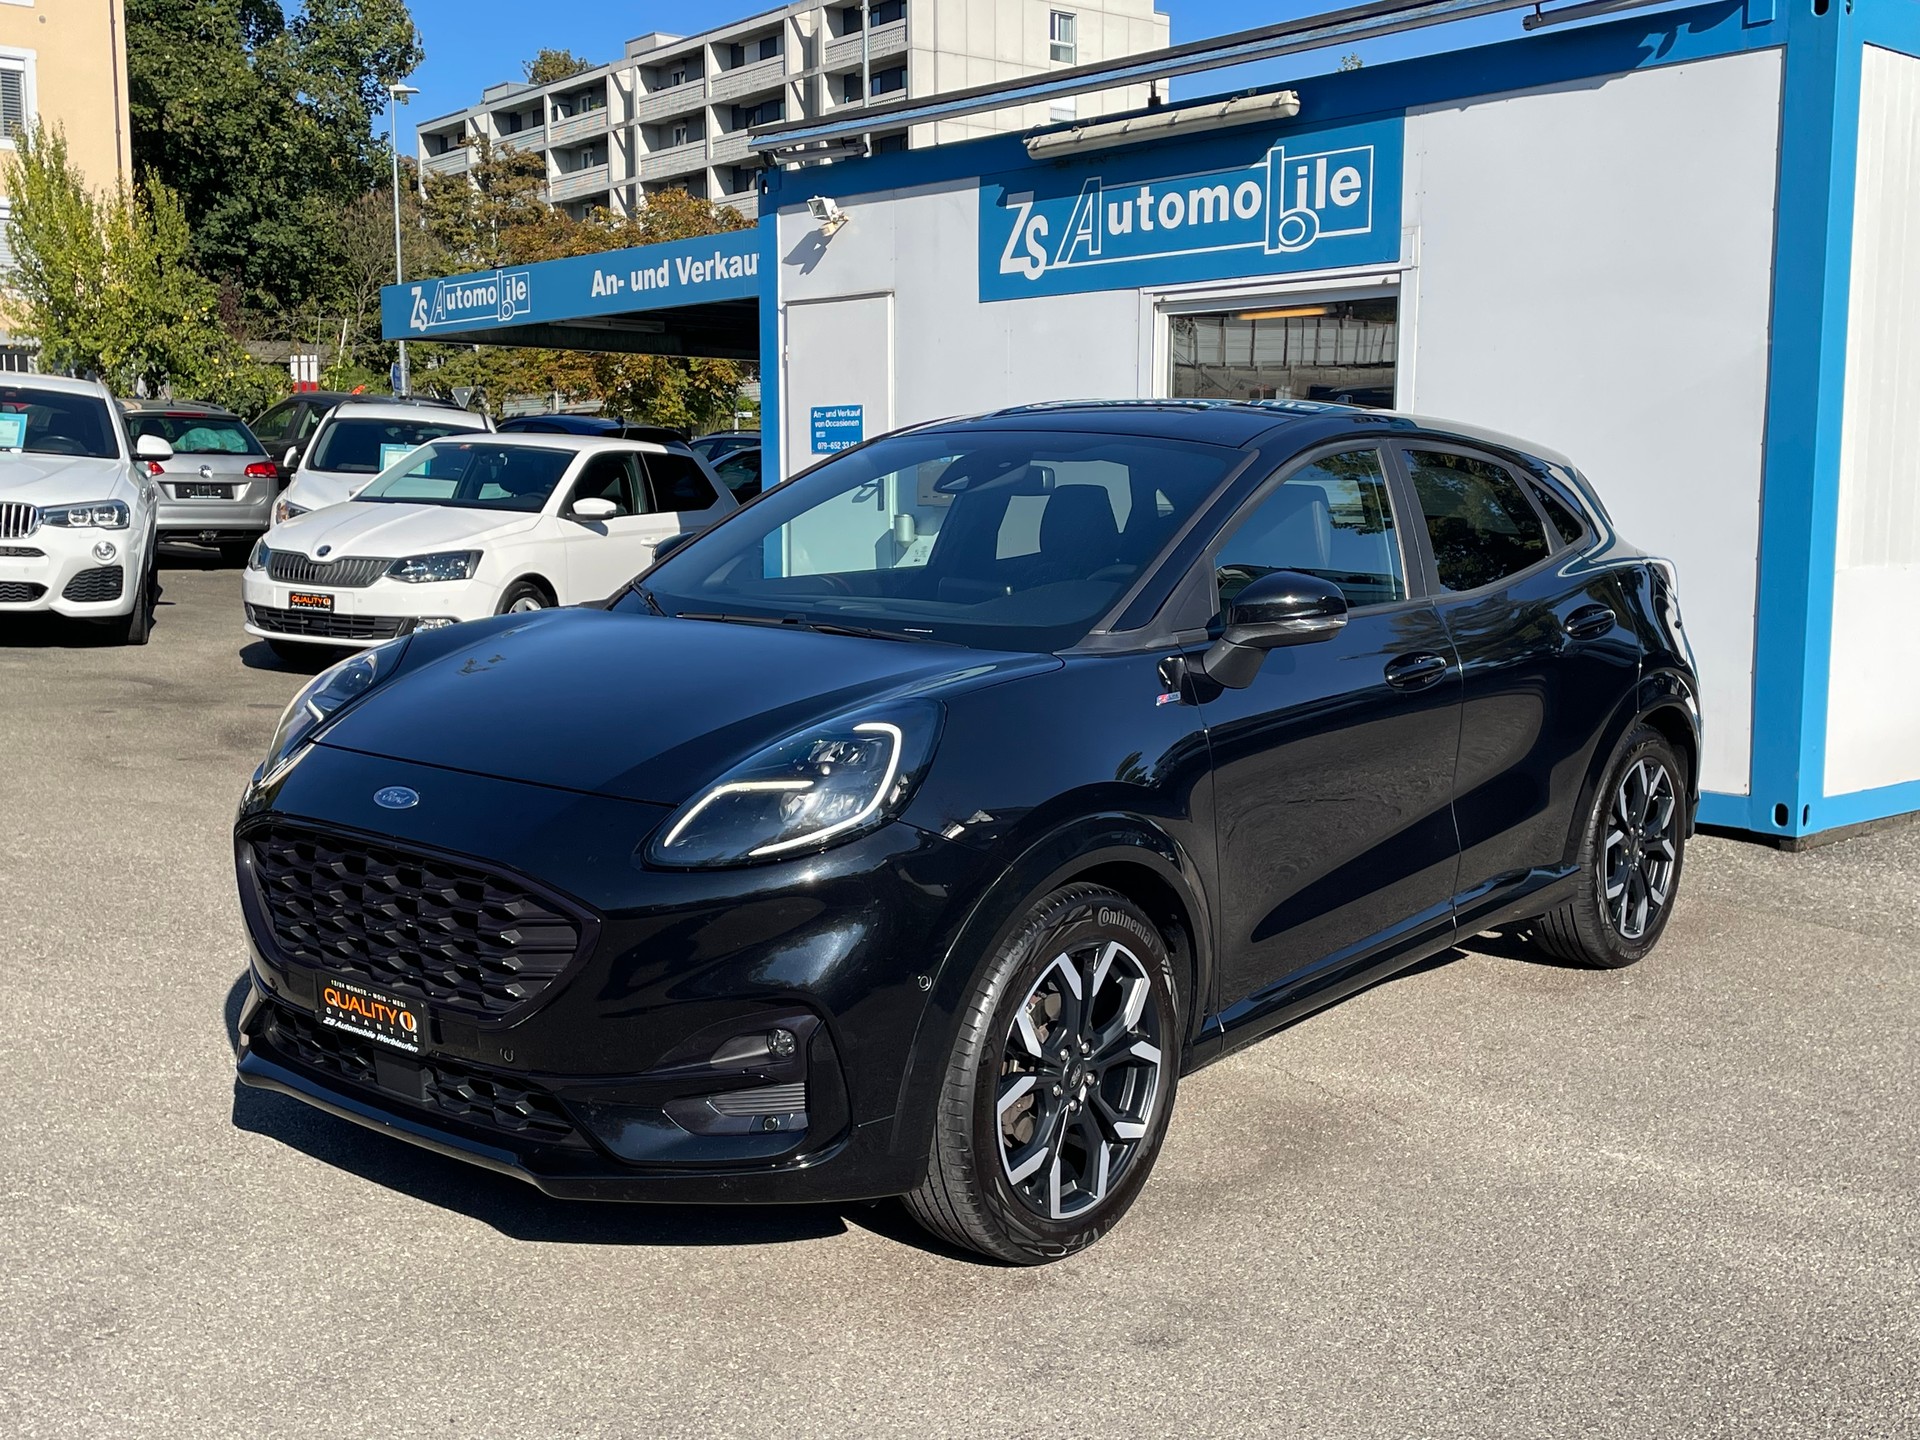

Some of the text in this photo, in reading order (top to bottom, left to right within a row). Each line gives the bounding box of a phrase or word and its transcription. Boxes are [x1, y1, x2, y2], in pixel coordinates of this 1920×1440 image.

[1056, 146, 1362, 265] Automobile
[591, 251, 760, 298] An- und Verkau
[431, 270, 527, 323] Automobile
[813, 408, 861, 418] An- und Verkauf
[825, 419, 860, 428] Occasionen
[291, 595, 323, 604] QUALITY
[1097, 906, 1154, 949] Continental
[324, 987, 397, 1025] QUALITY
[326, 1006, 418, 1042] GARANTIE
[335, 1020, 376, 1039] Automobile
[376, 1033, 419, 1053] Worblaufen
